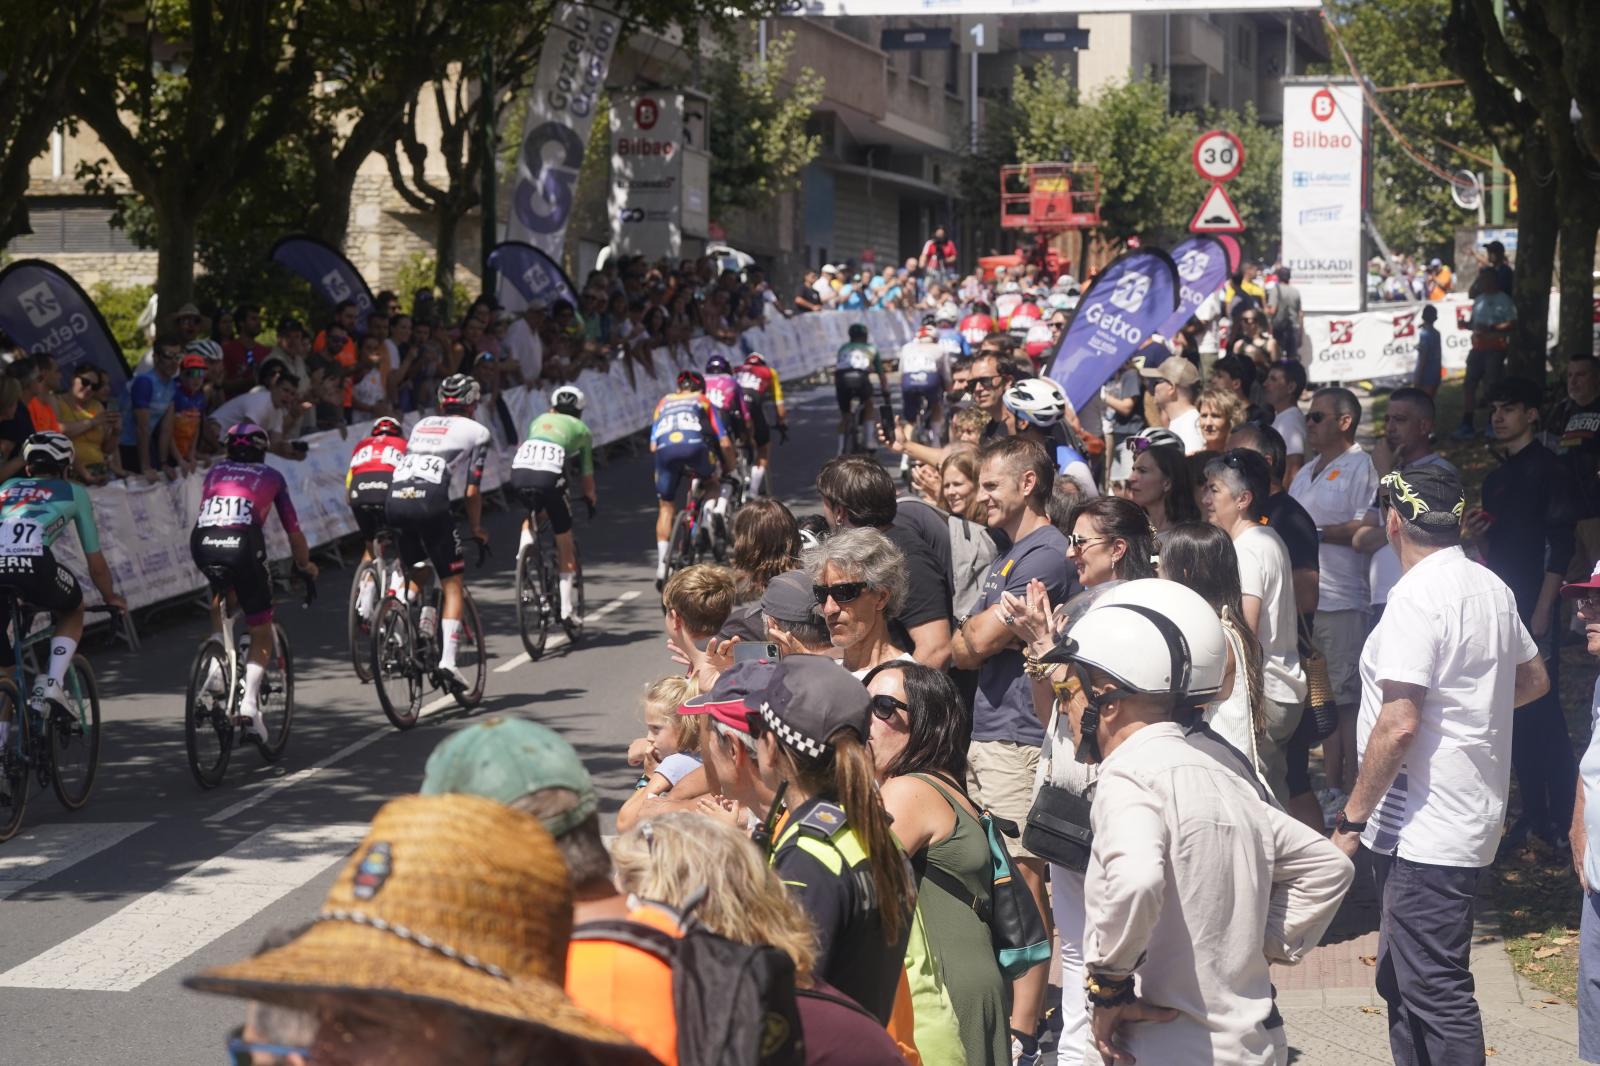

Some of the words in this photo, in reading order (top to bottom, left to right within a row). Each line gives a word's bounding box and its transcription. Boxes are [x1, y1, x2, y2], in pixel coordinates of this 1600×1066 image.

[548, 16, 591, 111] Gaztelu
[1293, 131, 1352, 148] Bilbao
[617, 140, 673, 156] Bilbao
[1204, 148, 1232, 164] 30
[1085, 302, 1142, 345] Getxo
[1319, 348, 1366, 361] Getxo
[420, 458, 440, 474] 34
[12, 523, 36, 543] 97
